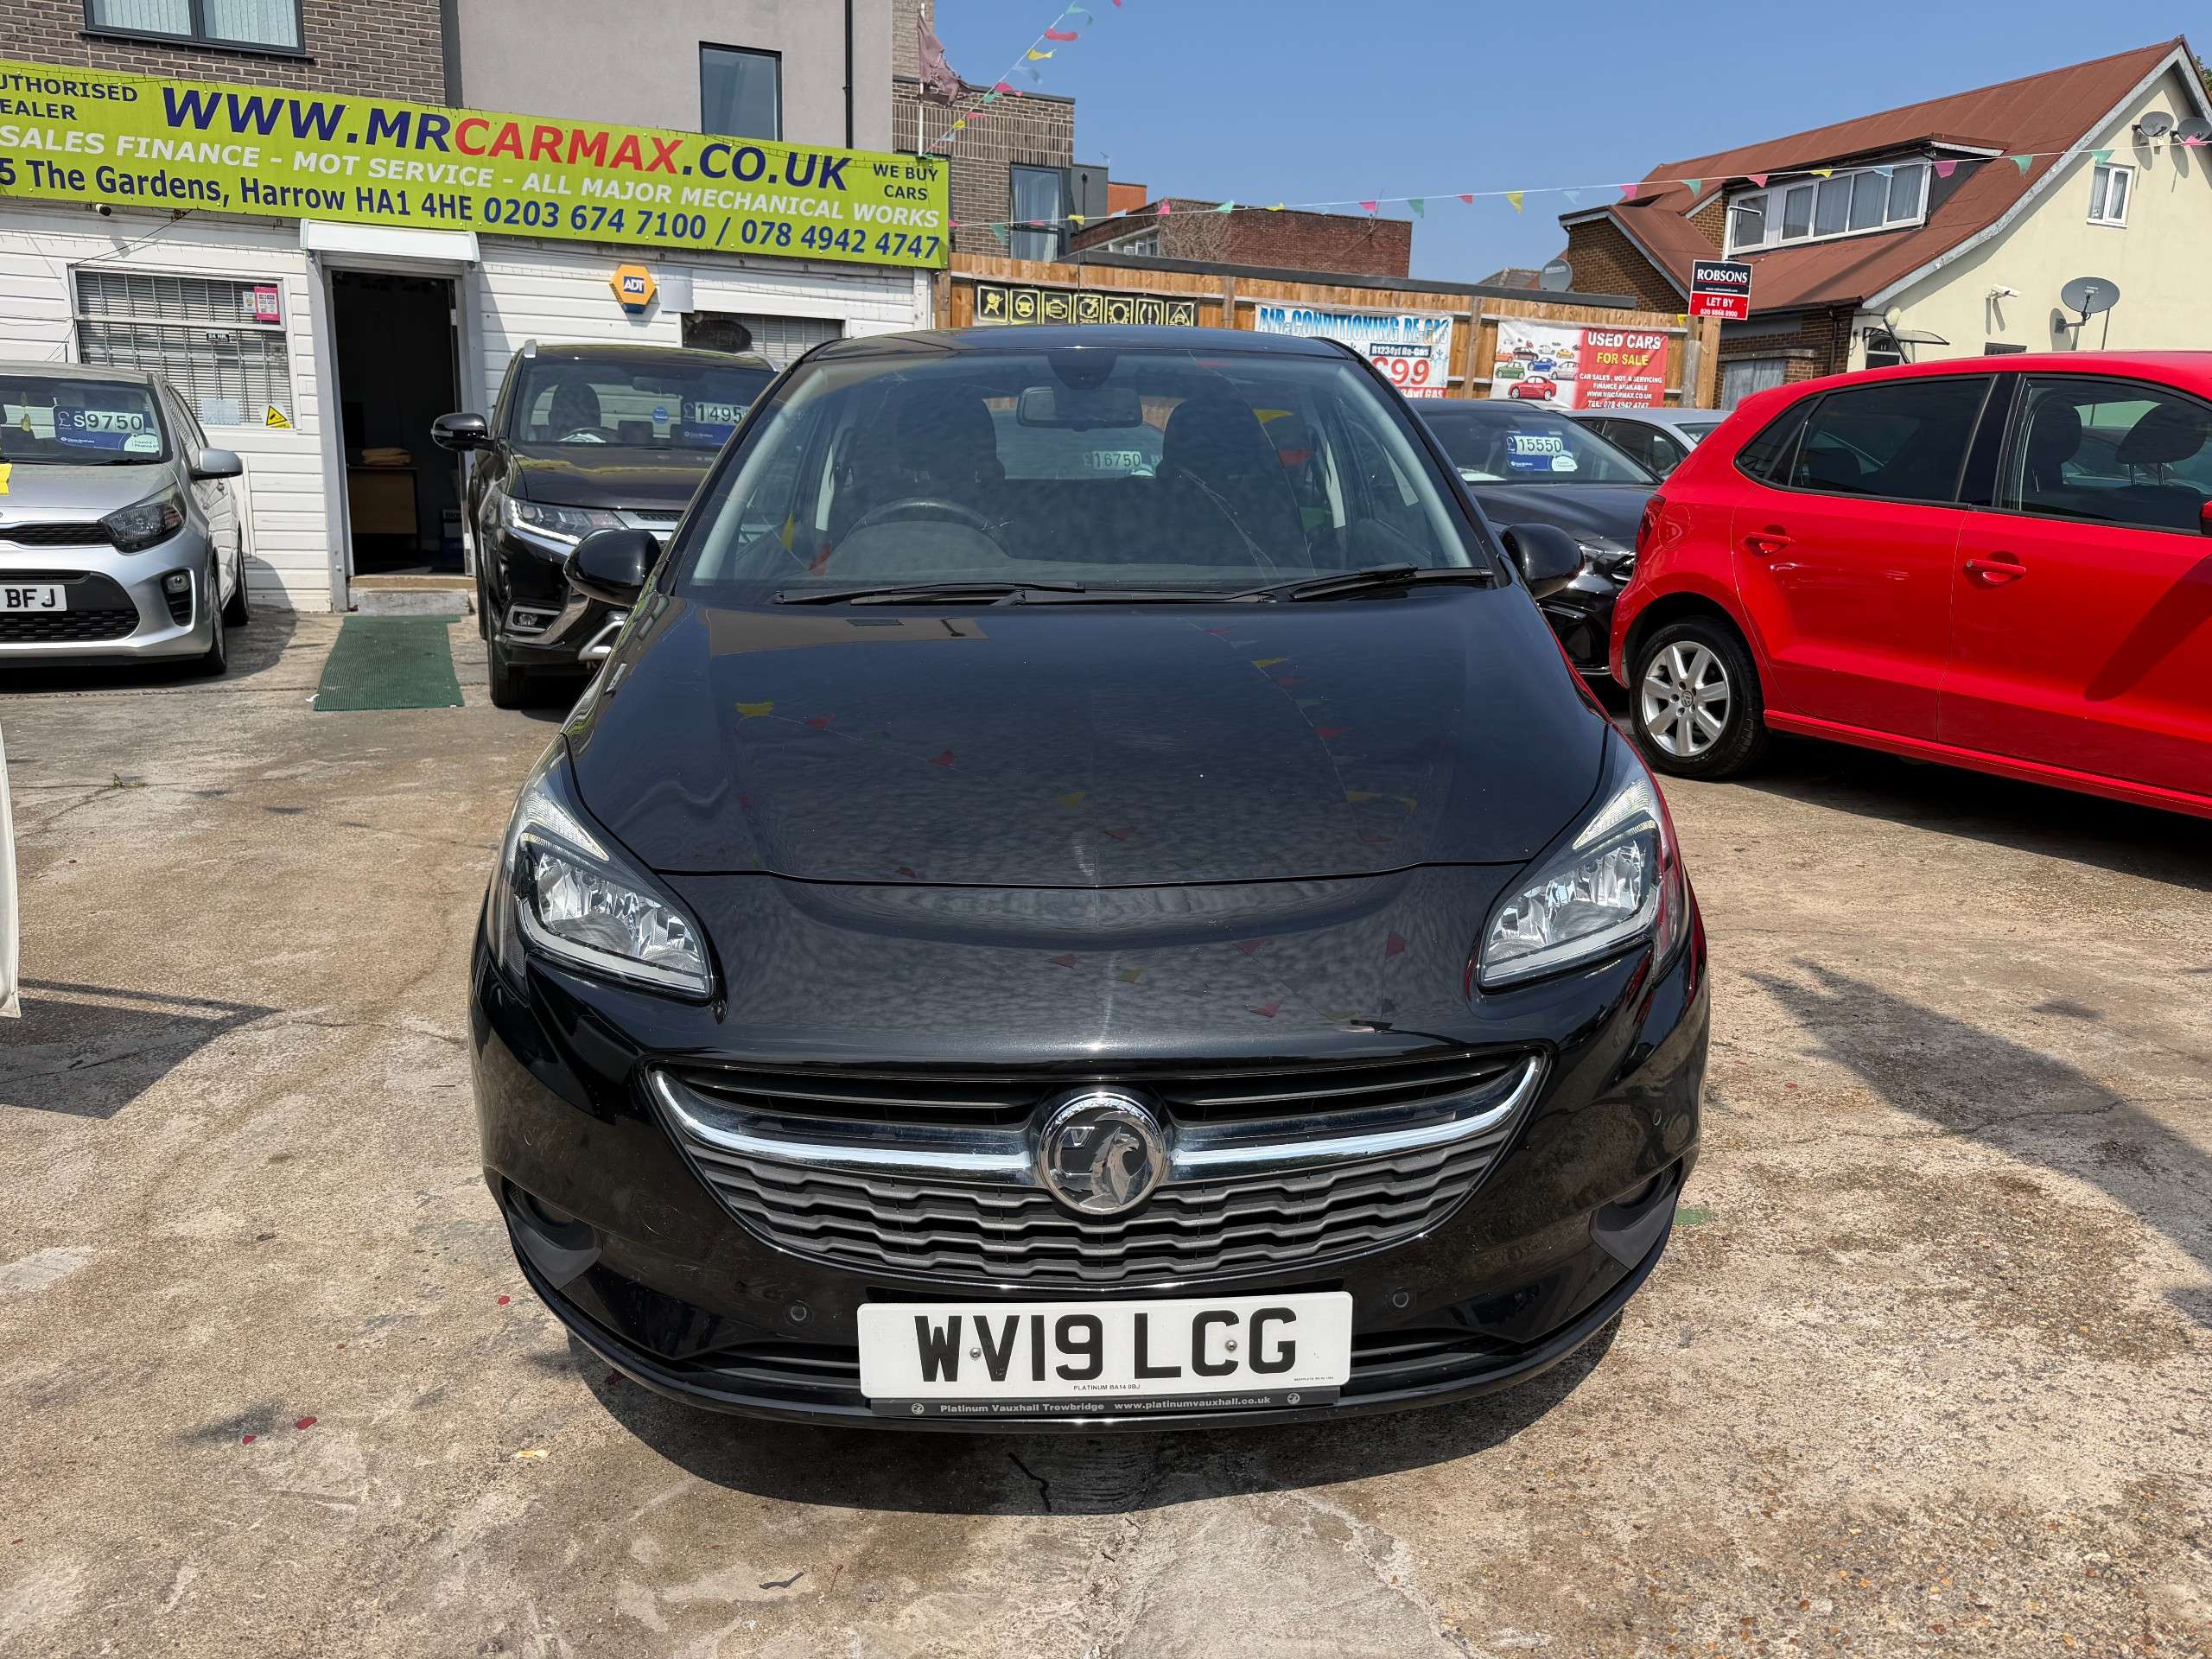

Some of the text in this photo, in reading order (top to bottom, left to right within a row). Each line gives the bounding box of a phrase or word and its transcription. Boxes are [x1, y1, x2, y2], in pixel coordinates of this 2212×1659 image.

[162, 87, 852, 191] WWW.MRCARMAX.CO.UK
[0, 125, 105, 154] SALES
[117, 135, 260, 167] FINANCE
[293, 150, 360, 175] MOT
[368, 157, 494, 188] SERVICE
[521, 172, 571, 195] ALL
[582, 177, 672, 204] MAJOR
[681, 187, 843, 219] MECHANICAL
[853, 203, 940, 228] WORKS
[873, 163, 938, 181] WE BUY
[884, 184, 928, 200] CARS
[26, 160, 86, 191] The
[96, 165, 229, 207] Gardens,
[240, 177, 345, 211] Harrow
[356, 187, 410, 215] HA1
[422, 193, 473, 220] 4HE
[484, 197, 560, 228] 0203
[570, 205, 625, 233] 674
[636, 210, 706, 239] 7100
[715, 217, 732, 245] /
[741, 219, 792, 246] 078
[801, 226, 866, 254] 4942
[874, 232, 940, 259] 4747
[624, 278, 645, 292] ADT
[1697, 269, 1748, 283] ROBSONS
[1706, 296, 1734, 308] LET BY
[1403, 317, 1449, 344] RE-GAS
[1587, 332, 1662, 350] USED CARS
[1596, 353, 1649, 366] FOR SALE
[5, 588, 55, 608] BFJ
[914, 1307, 1296, 1382] WV19 LCG
[940, 1396, 1271, 1413] Platinum Vauxhall Trowbridge www.platinumvauxhall.co.uk
